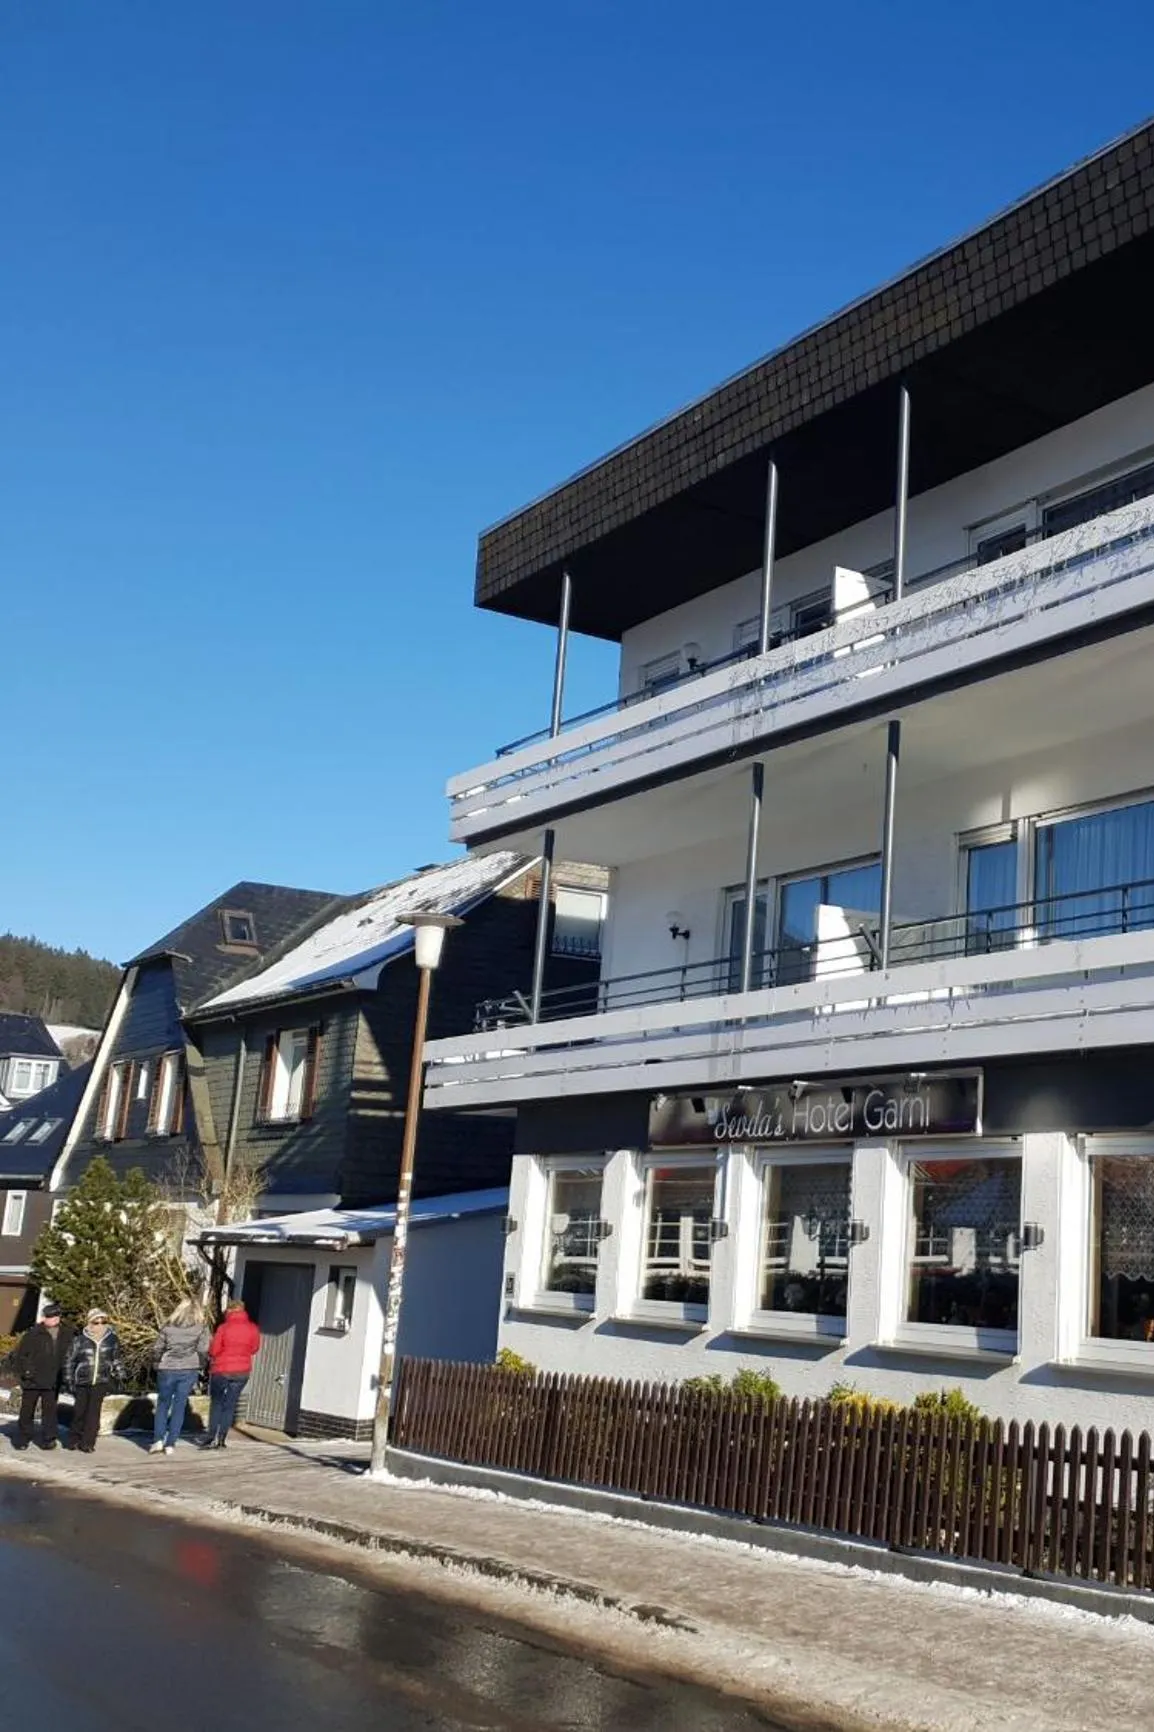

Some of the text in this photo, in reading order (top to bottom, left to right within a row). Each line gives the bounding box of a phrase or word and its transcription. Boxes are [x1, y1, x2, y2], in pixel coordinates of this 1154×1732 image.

[714, 1086, 930, 1139] Sevda's Hotel Garni
